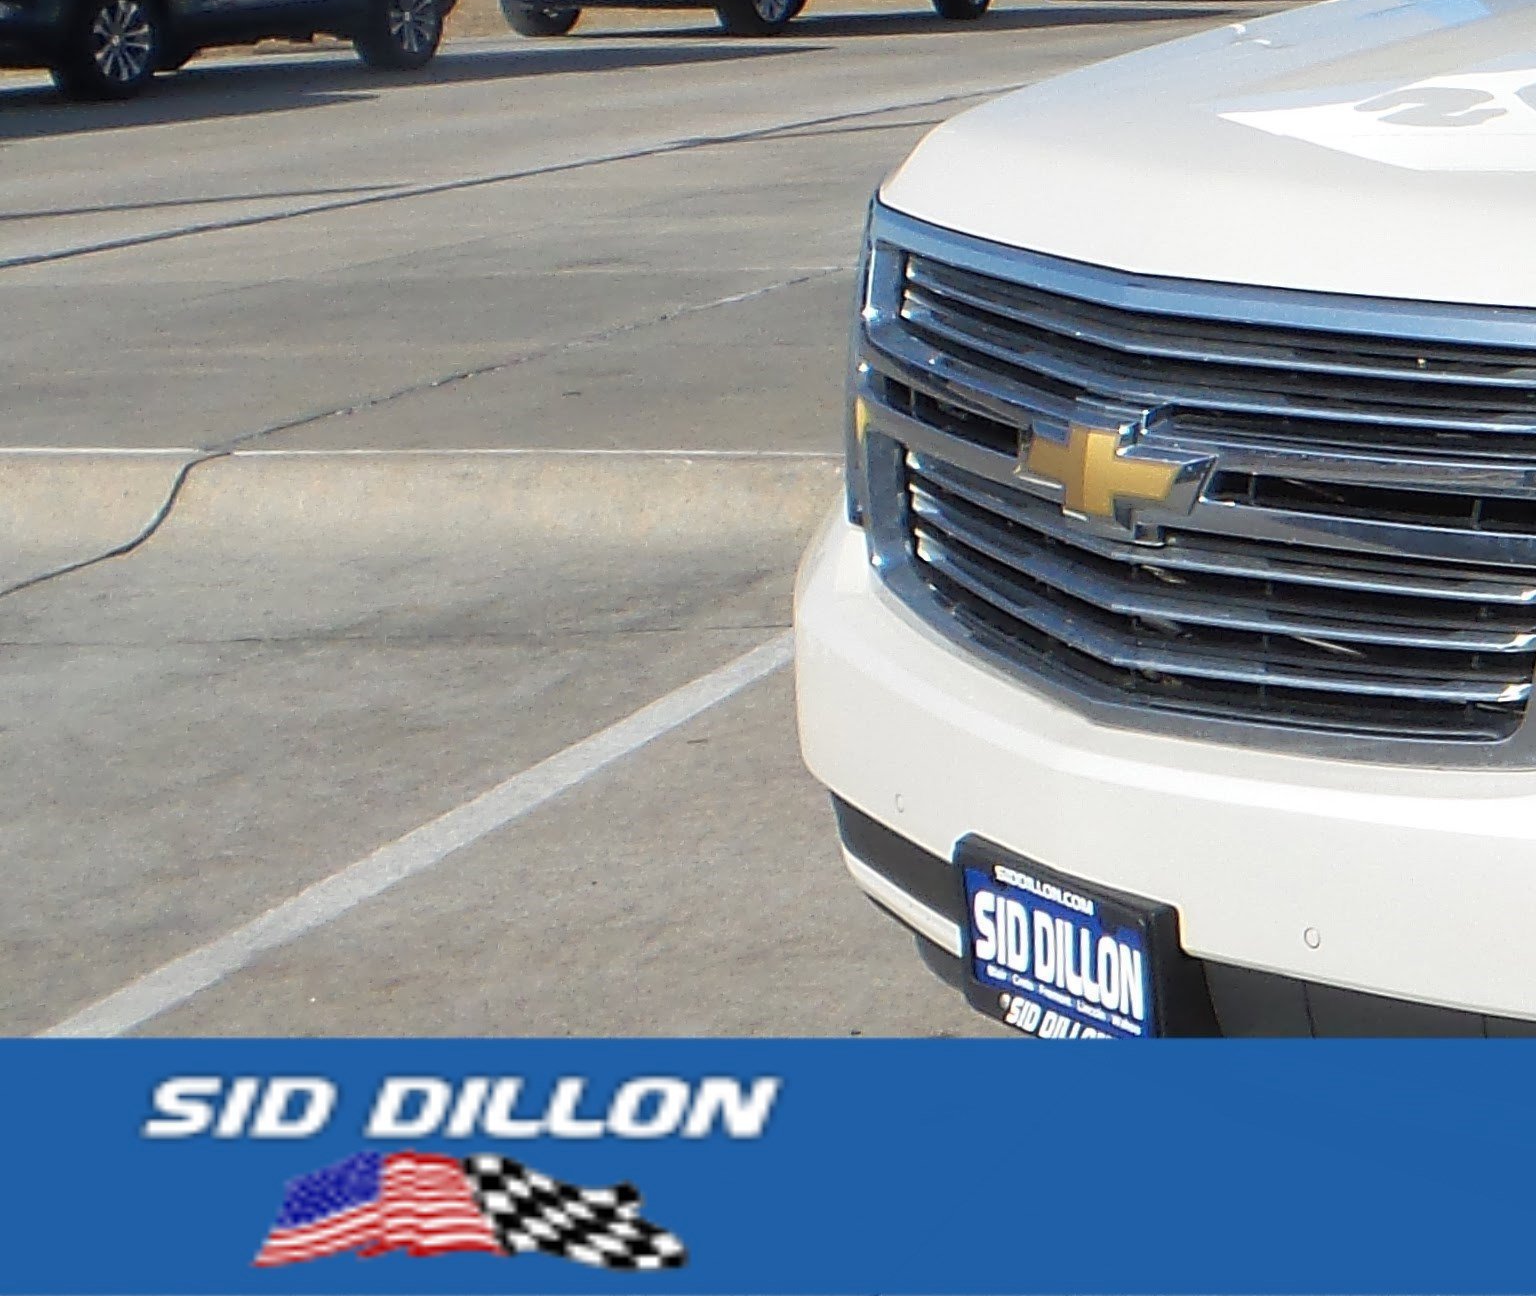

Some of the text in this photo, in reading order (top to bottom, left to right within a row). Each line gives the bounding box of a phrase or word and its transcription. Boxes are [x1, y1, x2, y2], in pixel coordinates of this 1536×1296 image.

[973, 890, 1145, 1021] SID DILLON
[1004, 995, 1042, 1033] SID
